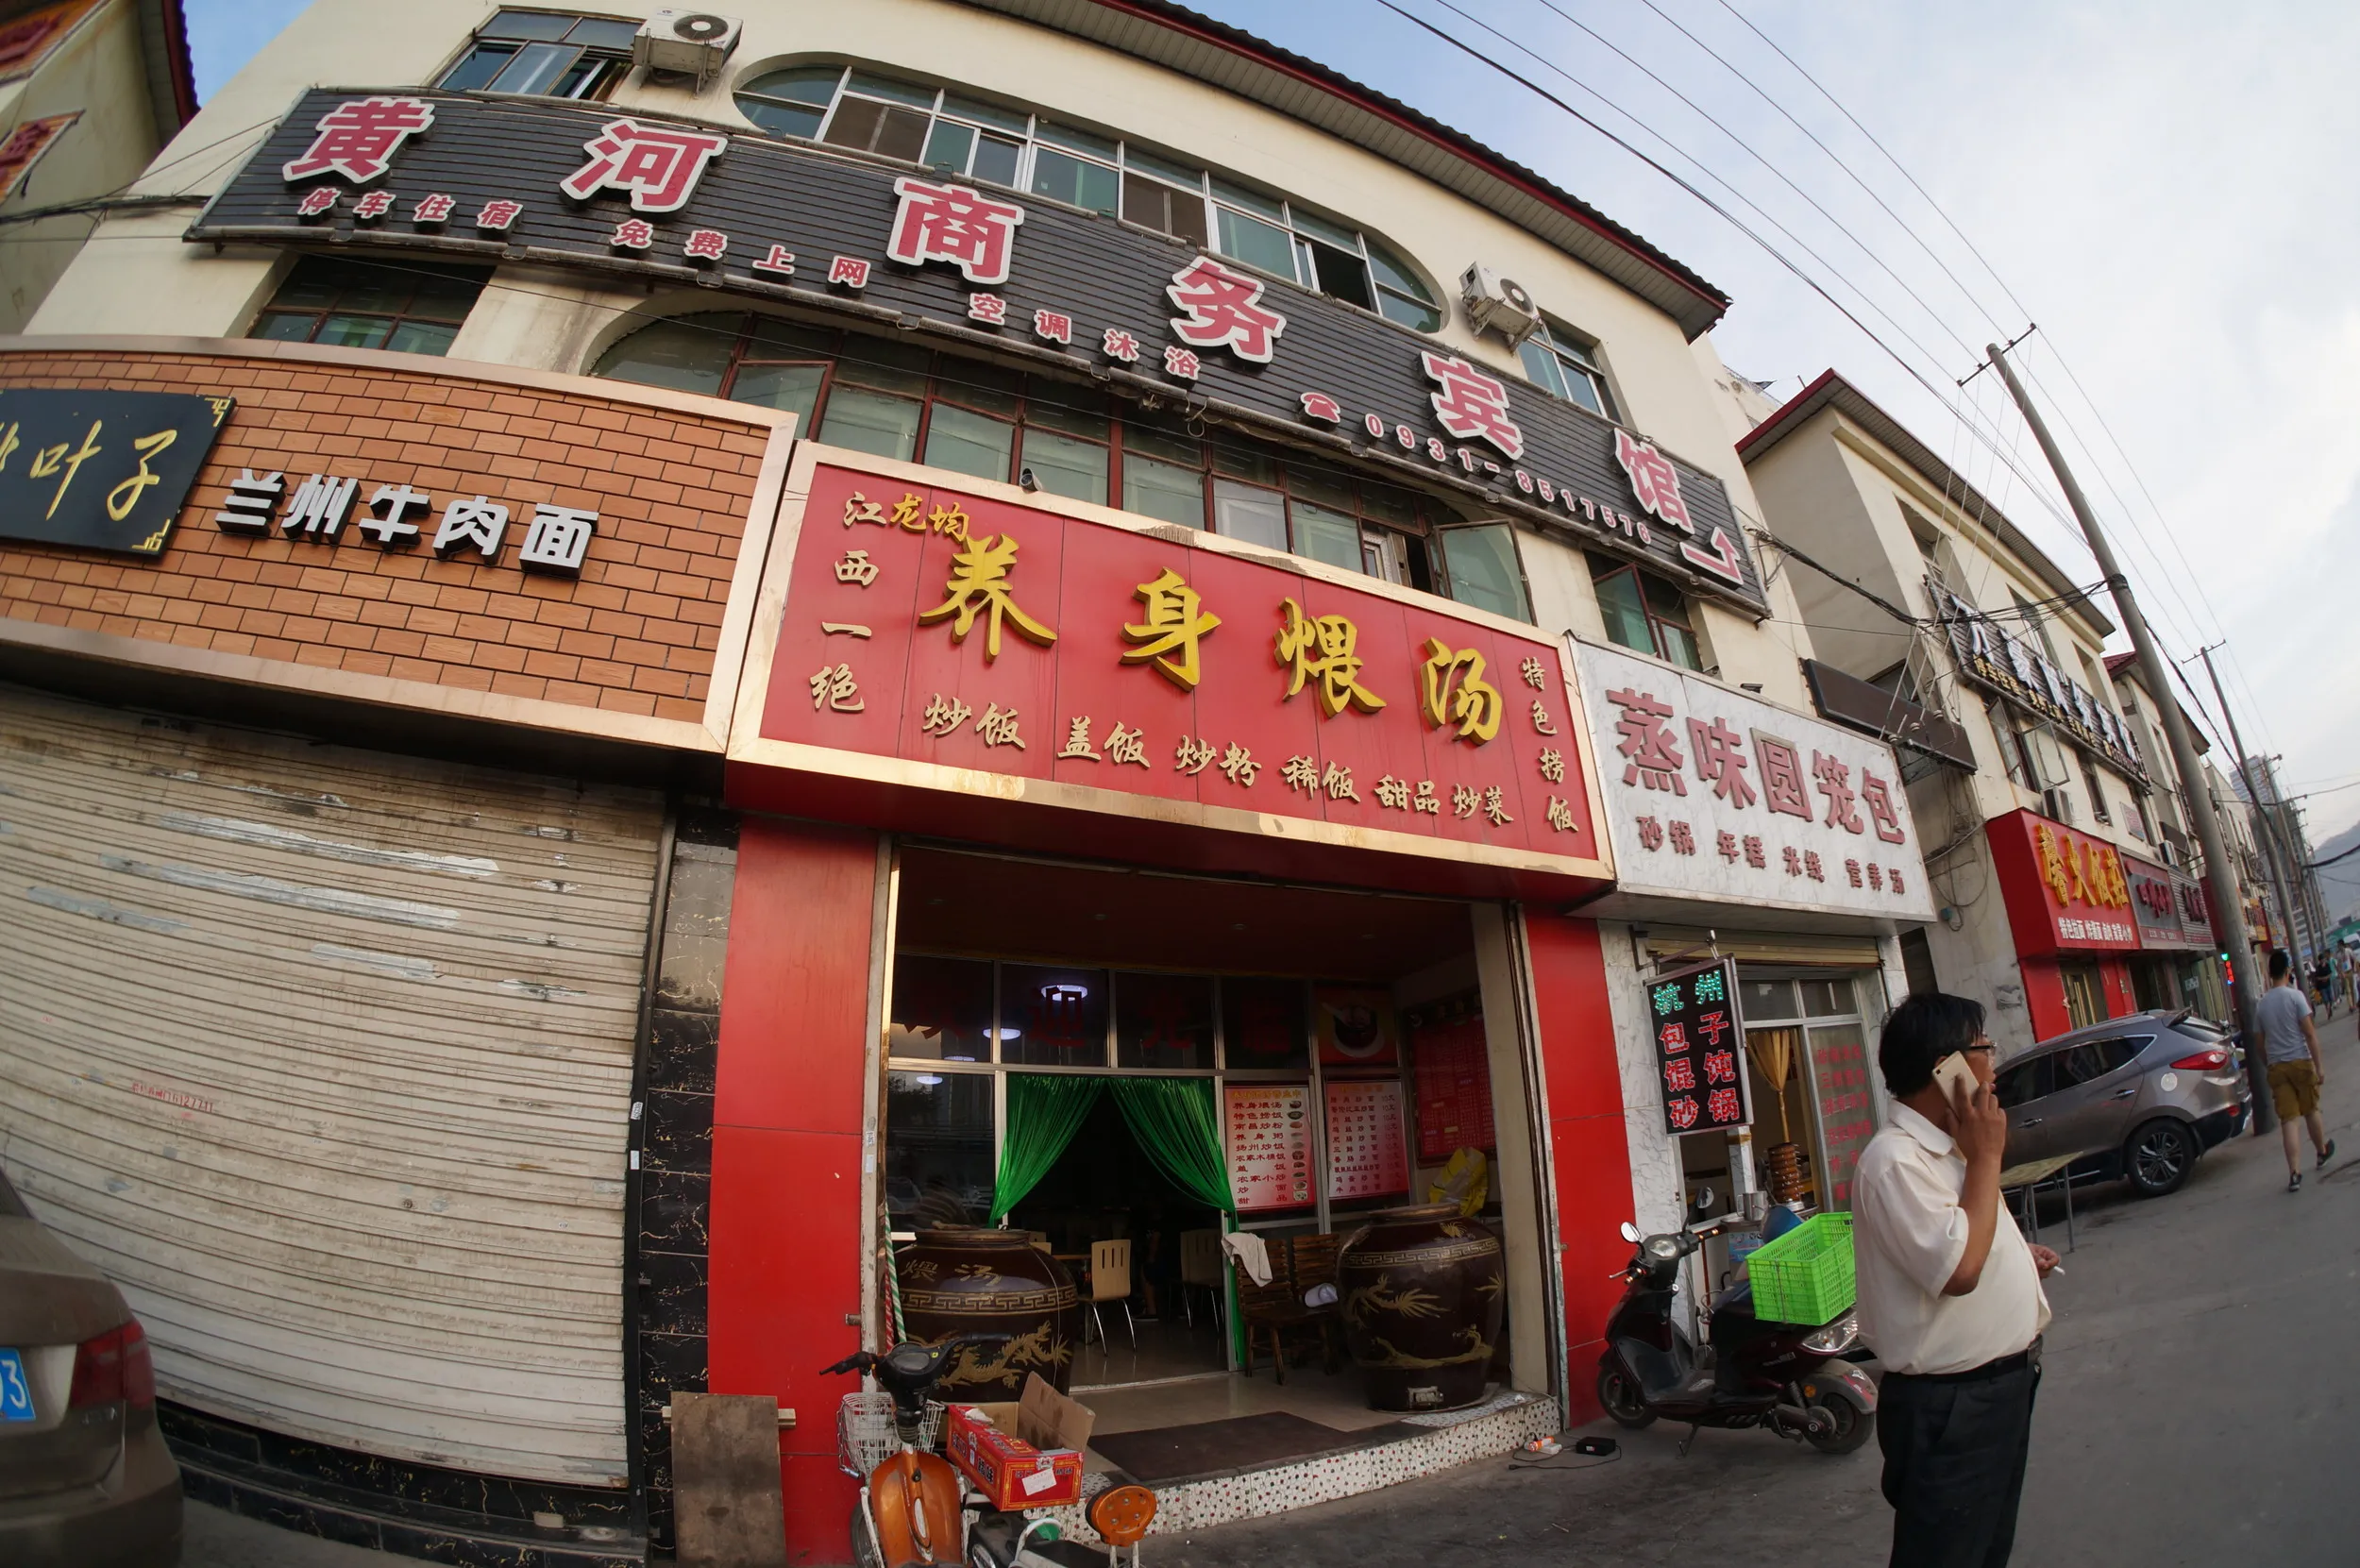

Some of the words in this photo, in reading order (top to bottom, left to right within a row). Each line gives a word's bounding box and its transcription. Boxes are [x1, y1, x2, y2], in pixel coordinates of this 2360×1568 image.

[285, 97, 1694, 534] 黄河商务宾馆
[298, 188, 523, 231] 停车住宿
[611, 218, 871, 289] 免费上网
[969, 293, 1200, 380] 空调沐浴
[1364, 413, 1652, 545] 0931-8517576
[215, 468, 598, 579] 兰州牛肉面
[809, 491, 886, 713] 江西一绝
[918, 533, 1503, 746] 养身煨汤
[921, 693, 1026, 750] 炒饭
[1058, 716, 1151, 769] 盖饭
[1175, 734, 1262, 786] 炒粉
[1281, 754, 1360, 803] 稀饭
[1374, 774, 1441, 815] 甜品
[1452, 783, 1514, 826] 炒菜
[1521, 656, 1578, 833] 特色捞饭
[1606, 687, 1906, 845] 蒸味圆笼包
[1636, 816, 1695, 855] 砂锅
[1718, 830, 1766, 869] 年糕
[1783, 846, 1825, 883] 米线
[1654, 969, 1724, 1016] 杭州
[1659, 1011, 1729, 1054] 包子
[1663, 1050, 1736, 1092] 馄饨
[1668, 1087, 1740, 1129] 砂锅
[0, 1359, 26, 1409] 3
